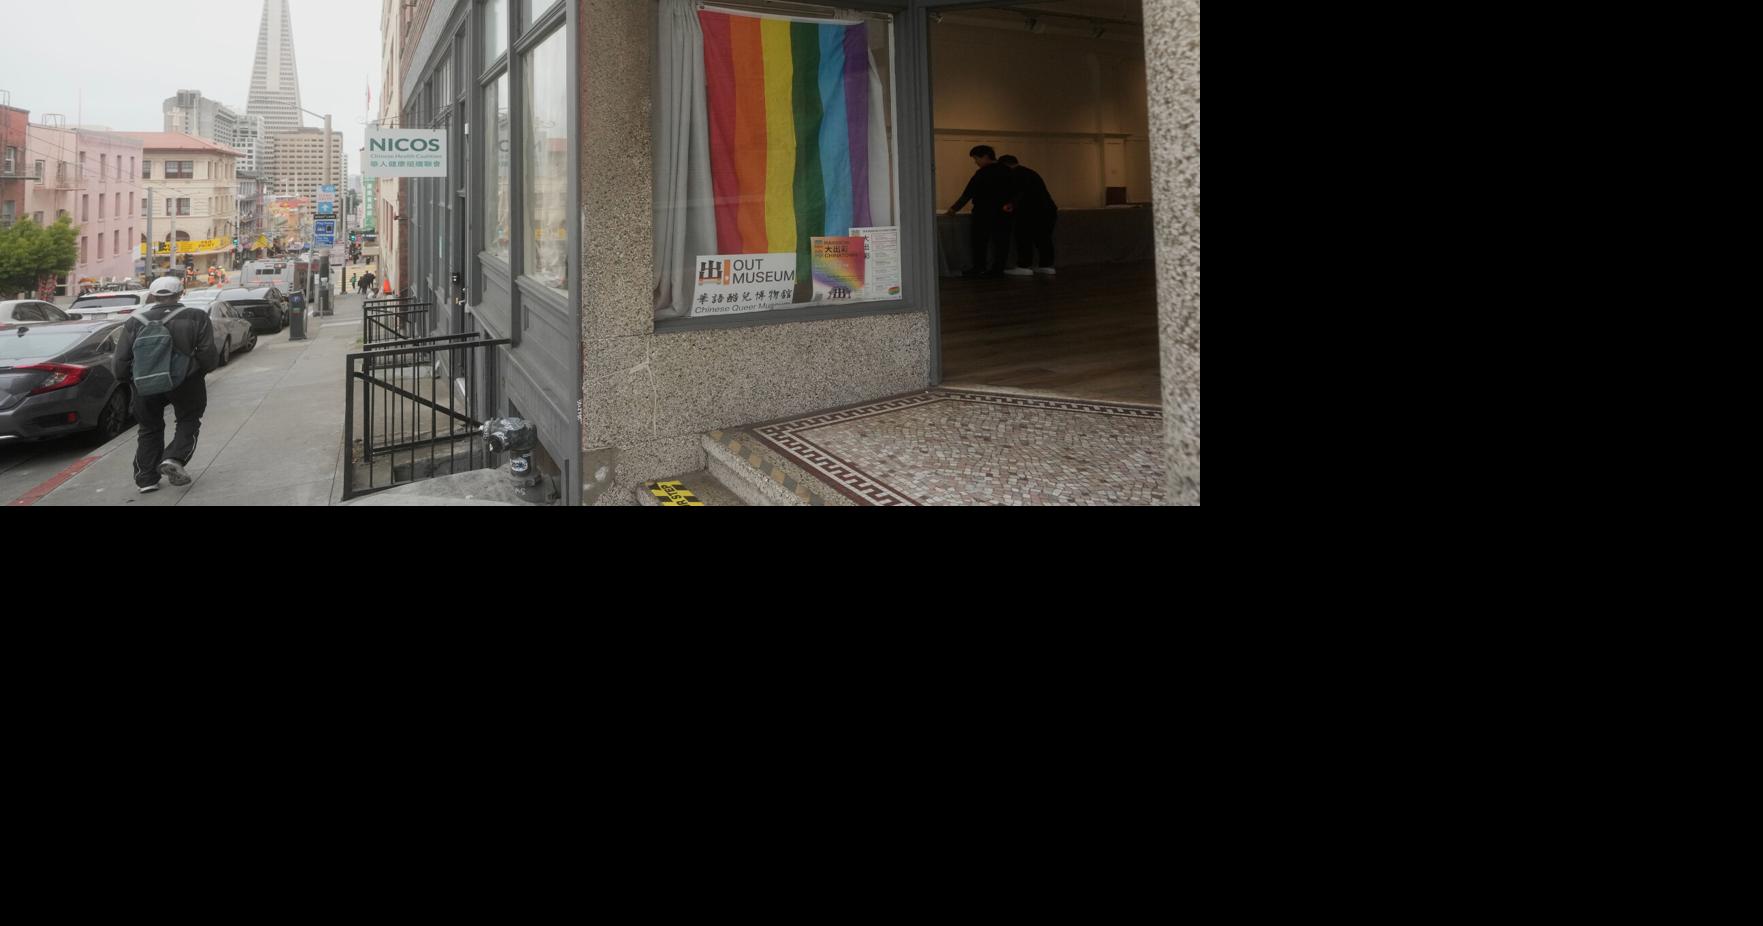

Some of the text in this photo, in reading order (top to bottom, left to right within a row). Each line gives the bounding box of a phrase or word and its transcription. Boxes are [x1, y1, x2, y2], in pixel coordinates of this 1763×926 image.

[370, 138, 440, 151] NICOS
[733, 259, 763, 272] OUT
[733, 270, 795, 285] MUSEUM
[695, 305, 730, 314] Chinese
[732, 303, 756, 312] Queer
[661, 485, 682, 500] STEP
